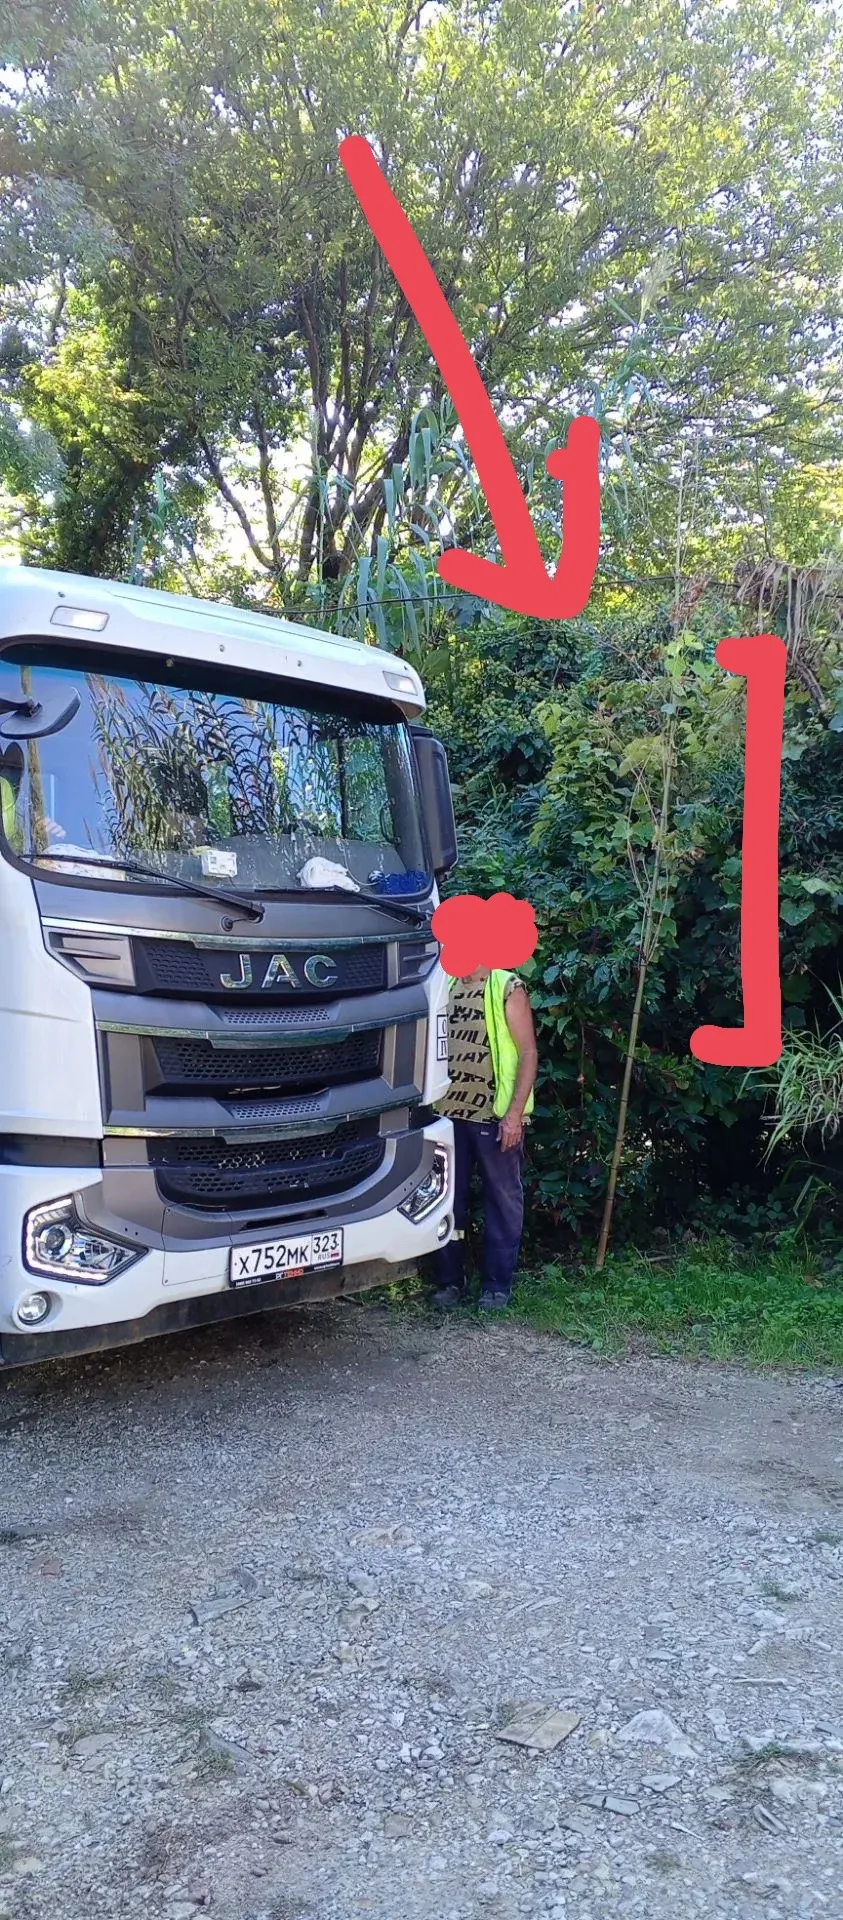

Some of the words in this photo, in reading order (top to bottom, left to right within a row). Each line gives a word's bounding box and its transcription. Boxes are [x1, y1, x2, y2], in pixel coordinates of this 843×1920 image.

[220, 953, 338, 988] JAC
[313, 1233, 338, 1254] 323
[317, 1252, 331, 1261] RUS
